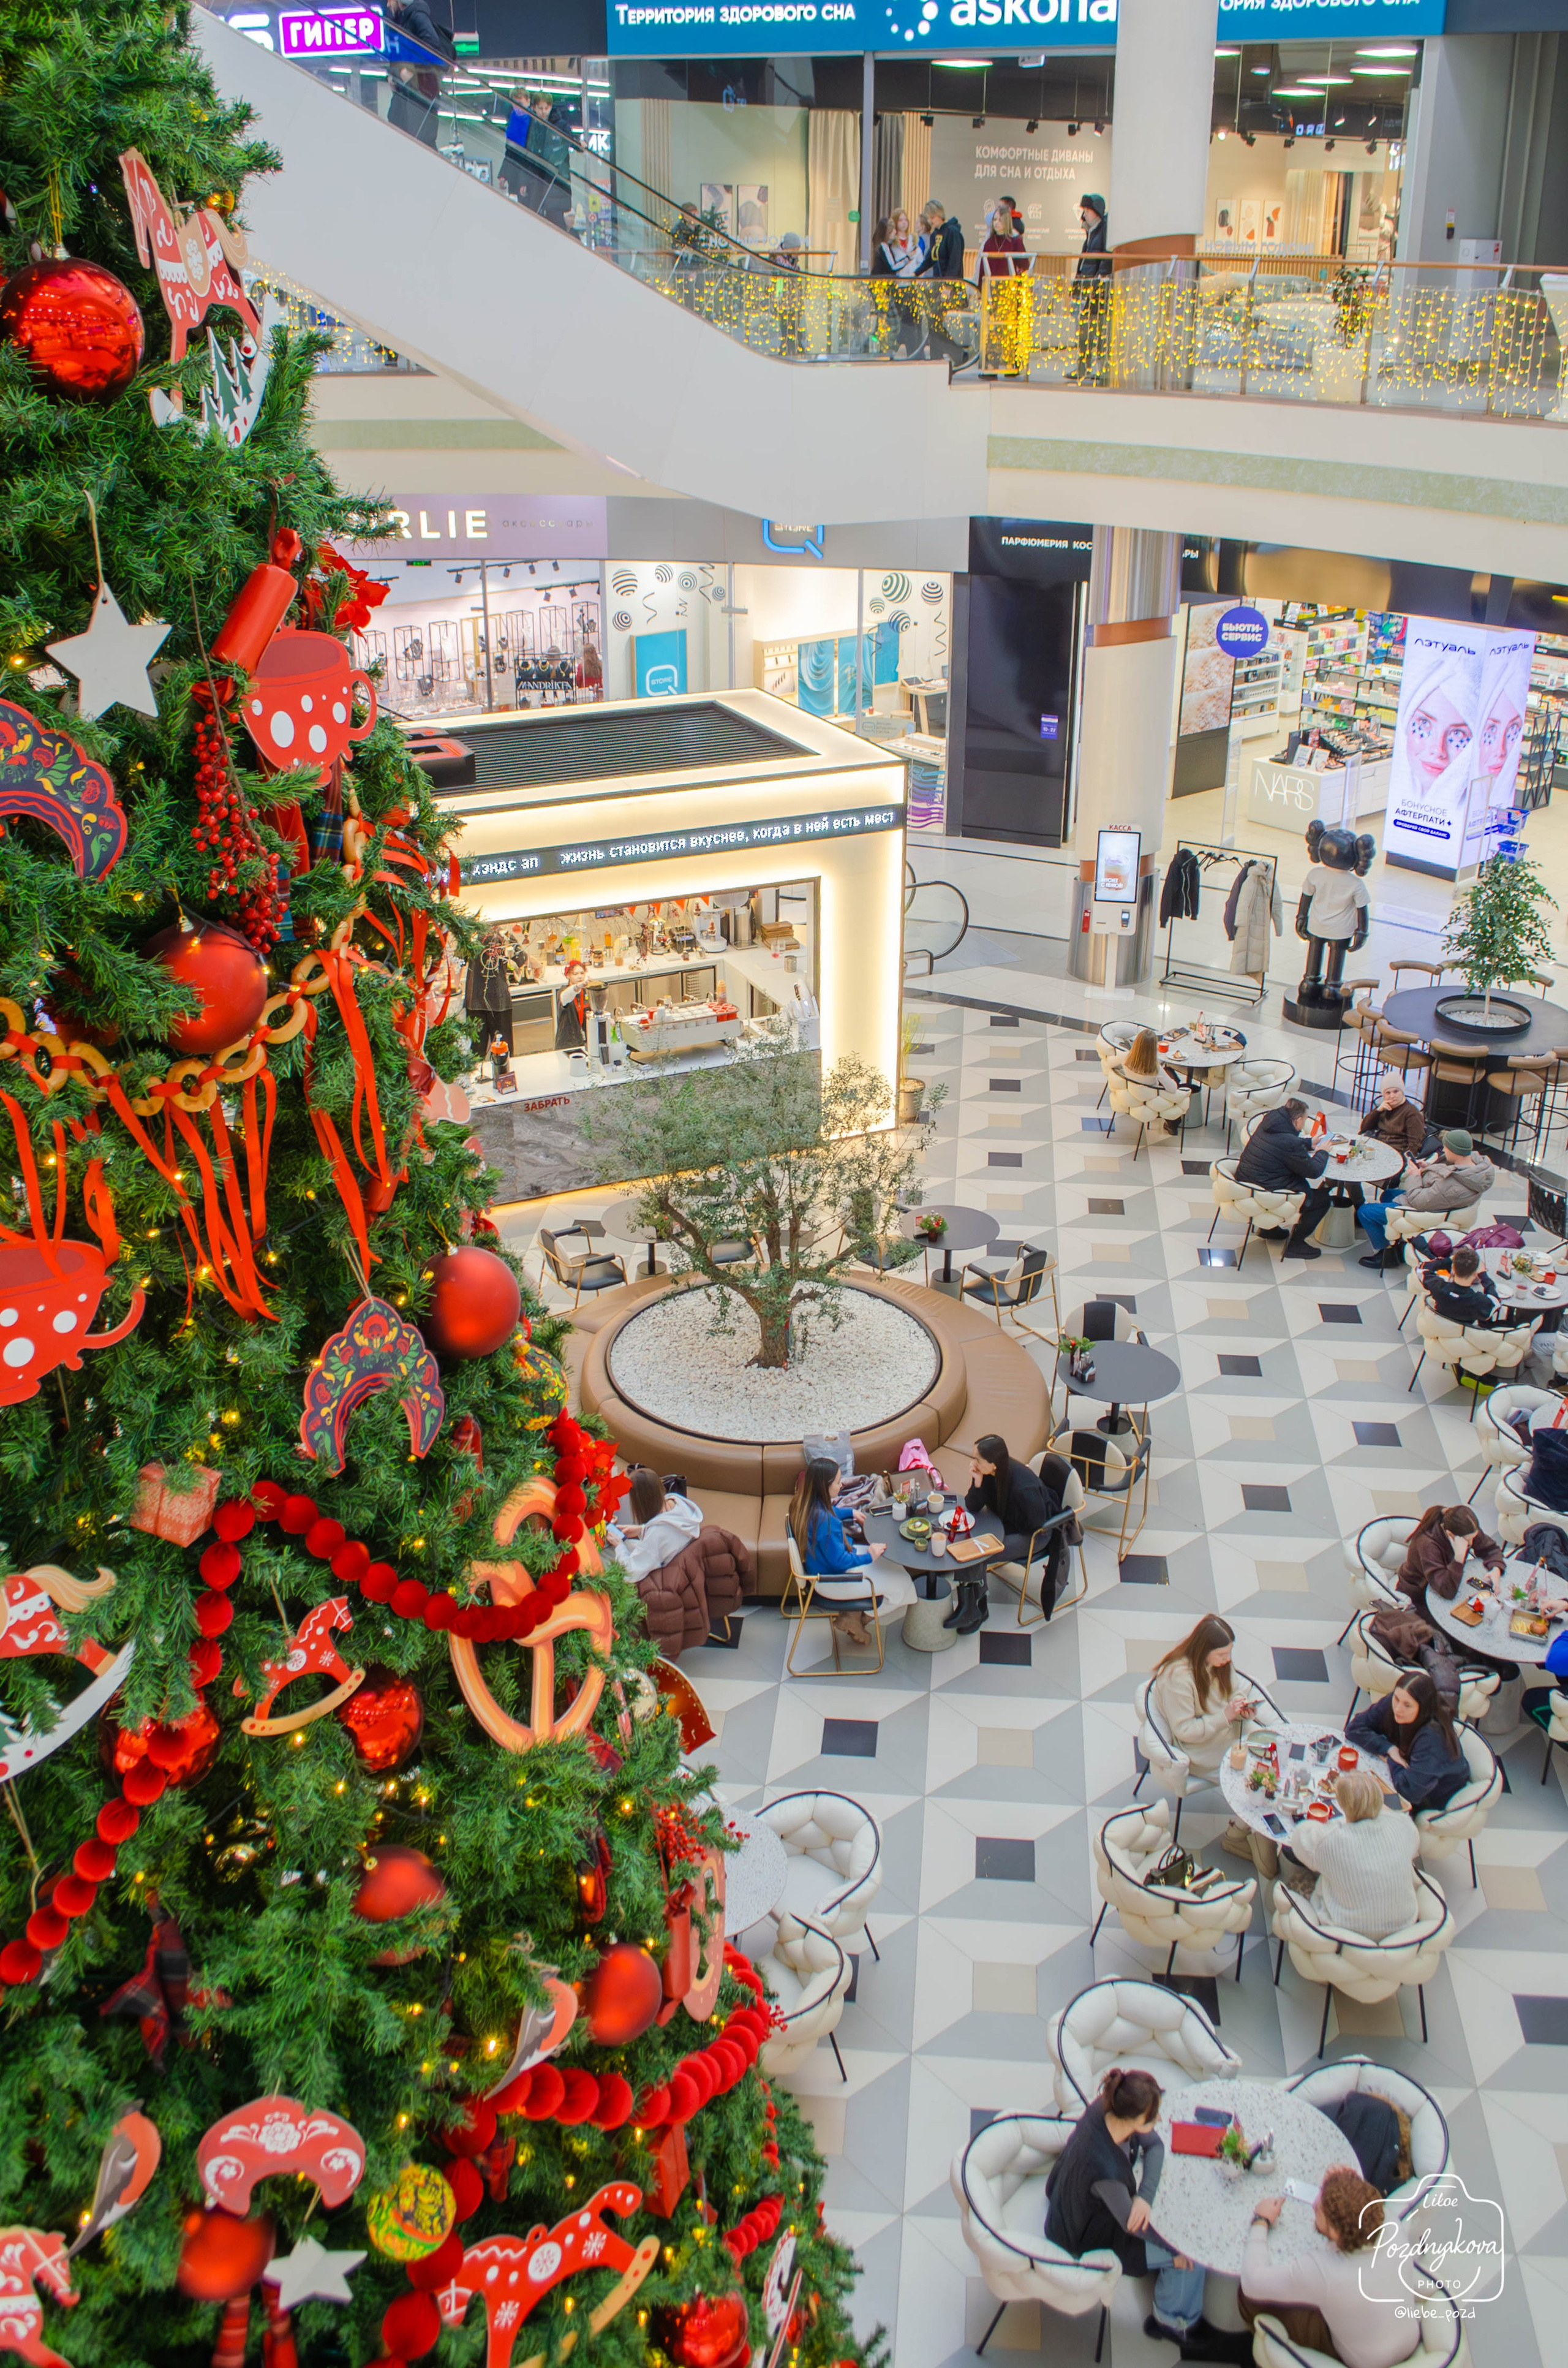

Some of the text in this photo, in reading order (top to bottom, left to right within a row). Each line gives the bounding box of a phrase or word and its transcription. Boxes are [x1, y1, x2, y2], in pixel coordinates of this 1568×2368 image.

[720, 5, 816, 25] ЗДОРОВОГО
[821, 4, 856, 21] СНА
[289, 18, 374, 47] ГИПЕР
[976, 145, 1093, 163] КОМФОРТНЫЕ ДИВАНЫ
[974, 164, 1076, 181] ДЛЯ СНА И ОТДЫХА
[1205, 240, 1256, 253] НОВЫМ
[1001, 536, 1068, 549] ПАРФЮМЕРИЯ
[1222, 632, 1262, 643] СЕРВИС
[1254, 768, 1315, 811] NARS
[1401, 799, 1448, 816] БОНУСНОЕ
[1395, 808, 1446, 826] АФТЕРПАТИ
[524, 1096, 570, 1112] ЗАБРАТЬ
